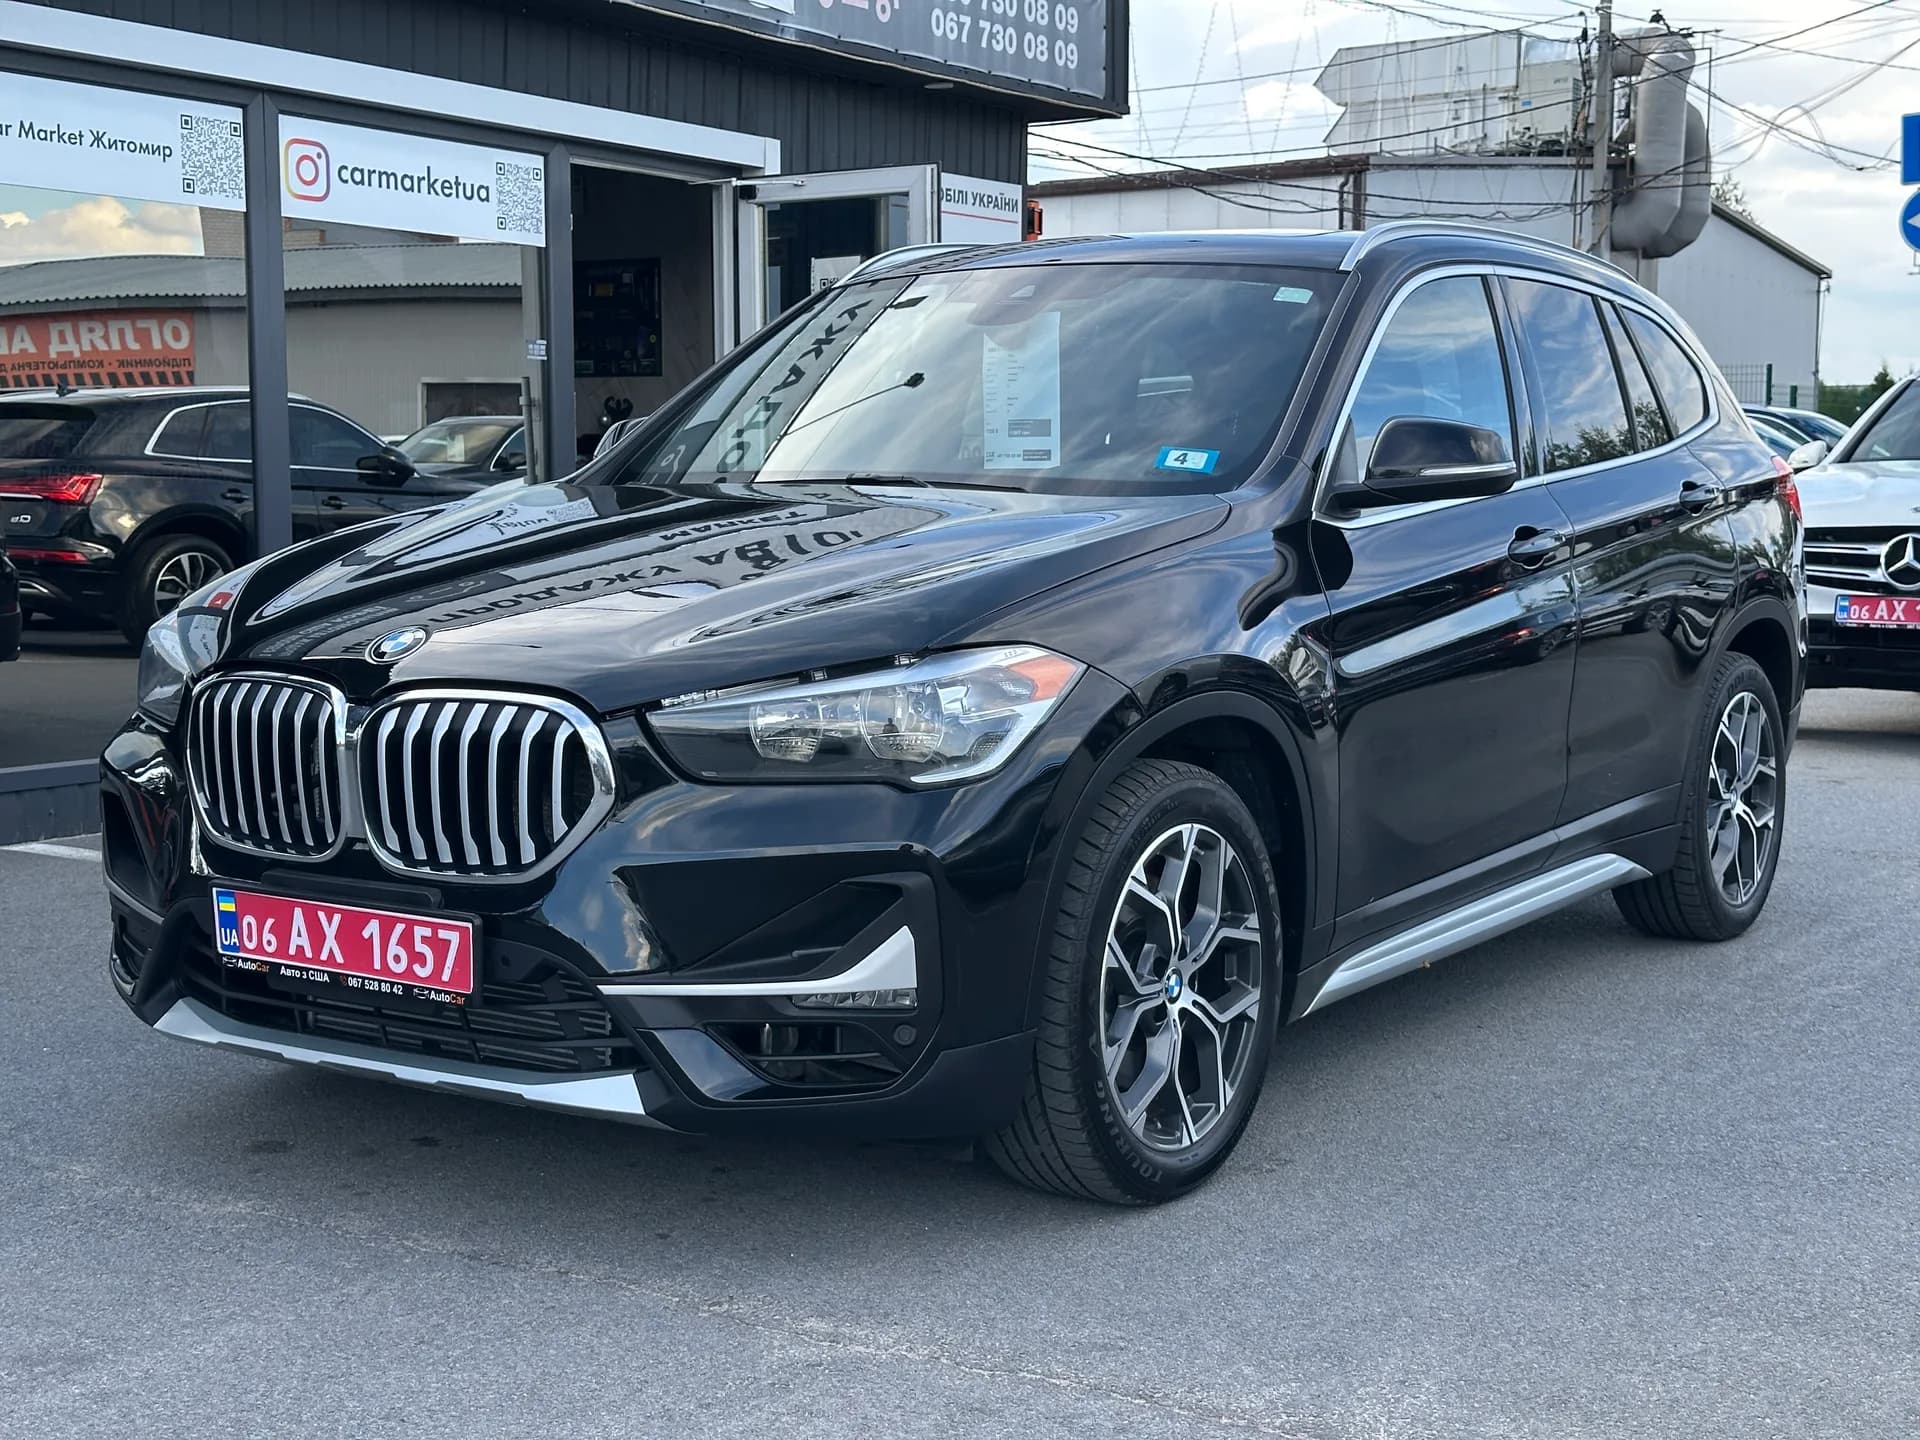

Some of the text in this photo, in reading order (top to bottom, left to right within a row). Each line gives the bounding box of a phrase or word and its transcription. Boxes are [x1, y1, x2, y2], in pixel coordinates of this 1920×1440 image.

[1024, 0, 1049, 25] 08
[1054, 4, 1078, 33] 09
[931, 8, 971, 43] 067
[979, 19, 1017, 54] 730
[1023, 32, 1049, 62] 08
[1054, 40, 1078, 69] 09
[18, 120, 84, 146] Market
[89, 129, 173, 162] Житомир
[337, 165, 490, 202] carmarketua
[971, 191, 1019, 213] УКРАЇНИ
[1174, 452, 1188, 465] 4
[1850, 600, 1907, 621] 06 AX
[221, 927, 239, 946] UA
[242, 907, 460, 982] 06 AX 1657
[237, 959, 270, 973] AutoCar
[280, 966, 301, 978] Авто
[308, 970, 330, 983] США
[347, 976, 403, 995] 067 528 80 42
[429, 990, 466, 1005] AutoCar
